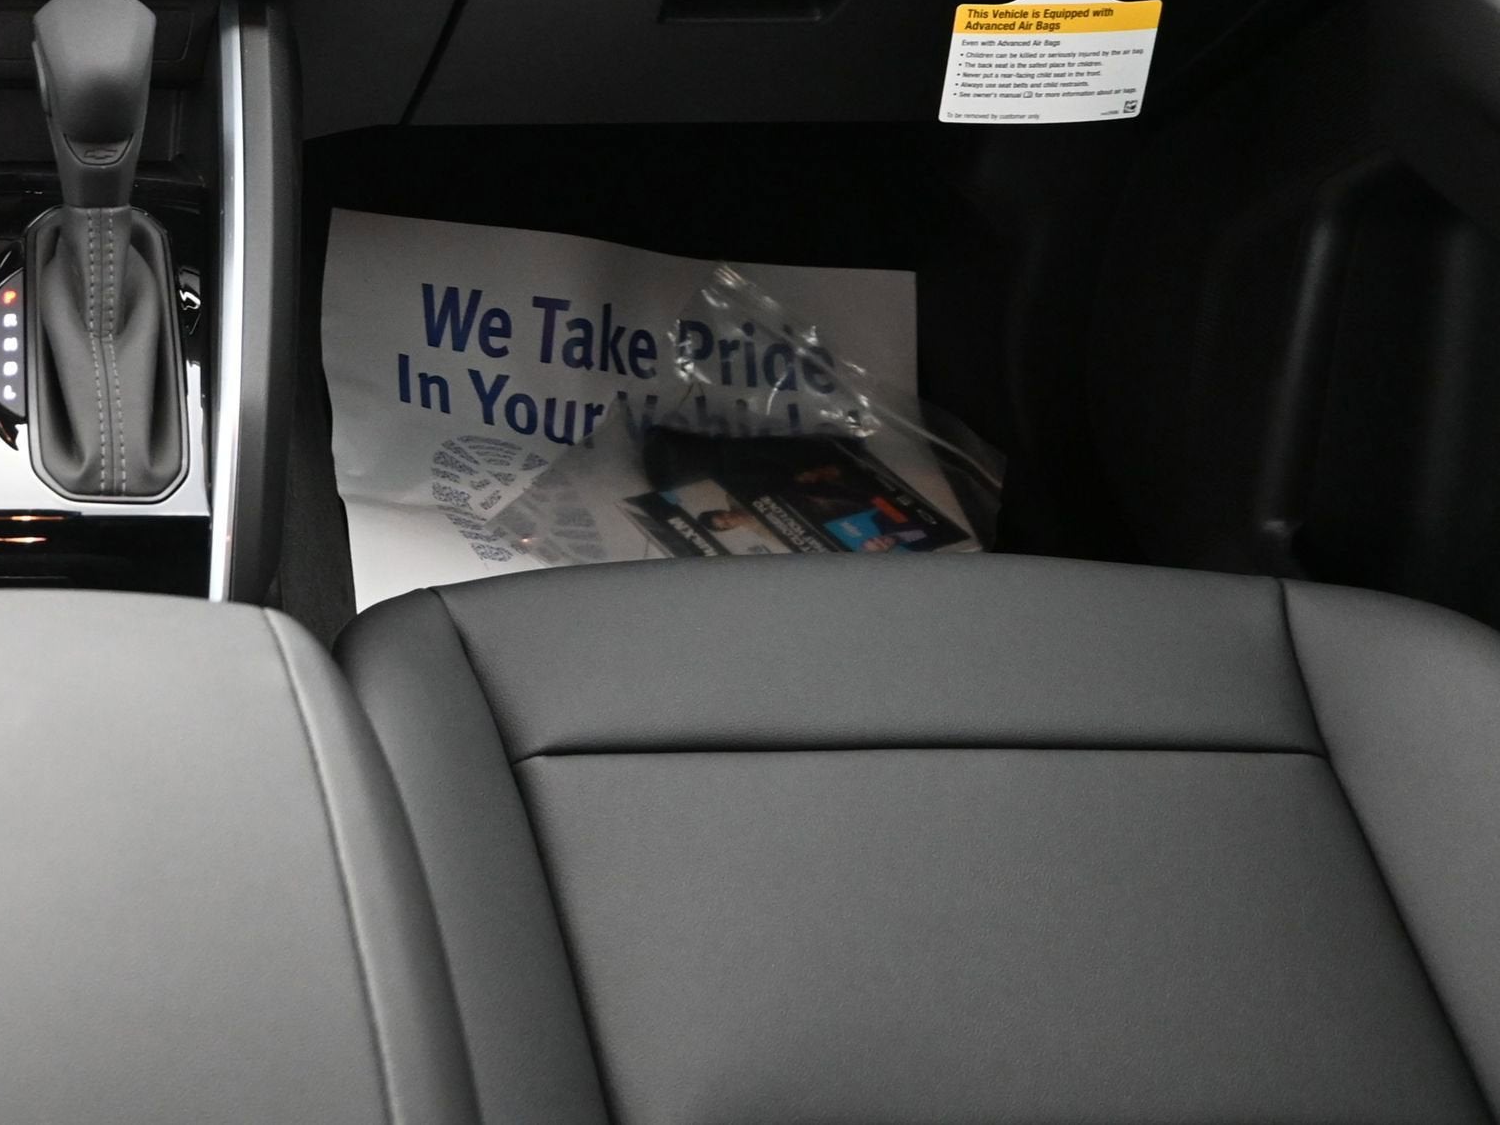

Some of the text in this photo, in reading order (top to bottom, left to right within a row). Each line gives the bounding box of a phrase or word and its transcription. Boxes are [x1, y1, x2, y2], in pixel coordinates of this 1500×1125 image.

[968, 7, 1114, 20] This Vehicle is Equipped with
[965, 21, 1061, 32] Advanced Air Bags
[997, 39, 1030, 47] Advanced
[1044, 39, 1060, 47] Bags
[421, 283, 840, 396] We Take Pride
[398, 353, 452, 415] In
[467, 368, 604, 448] Your
